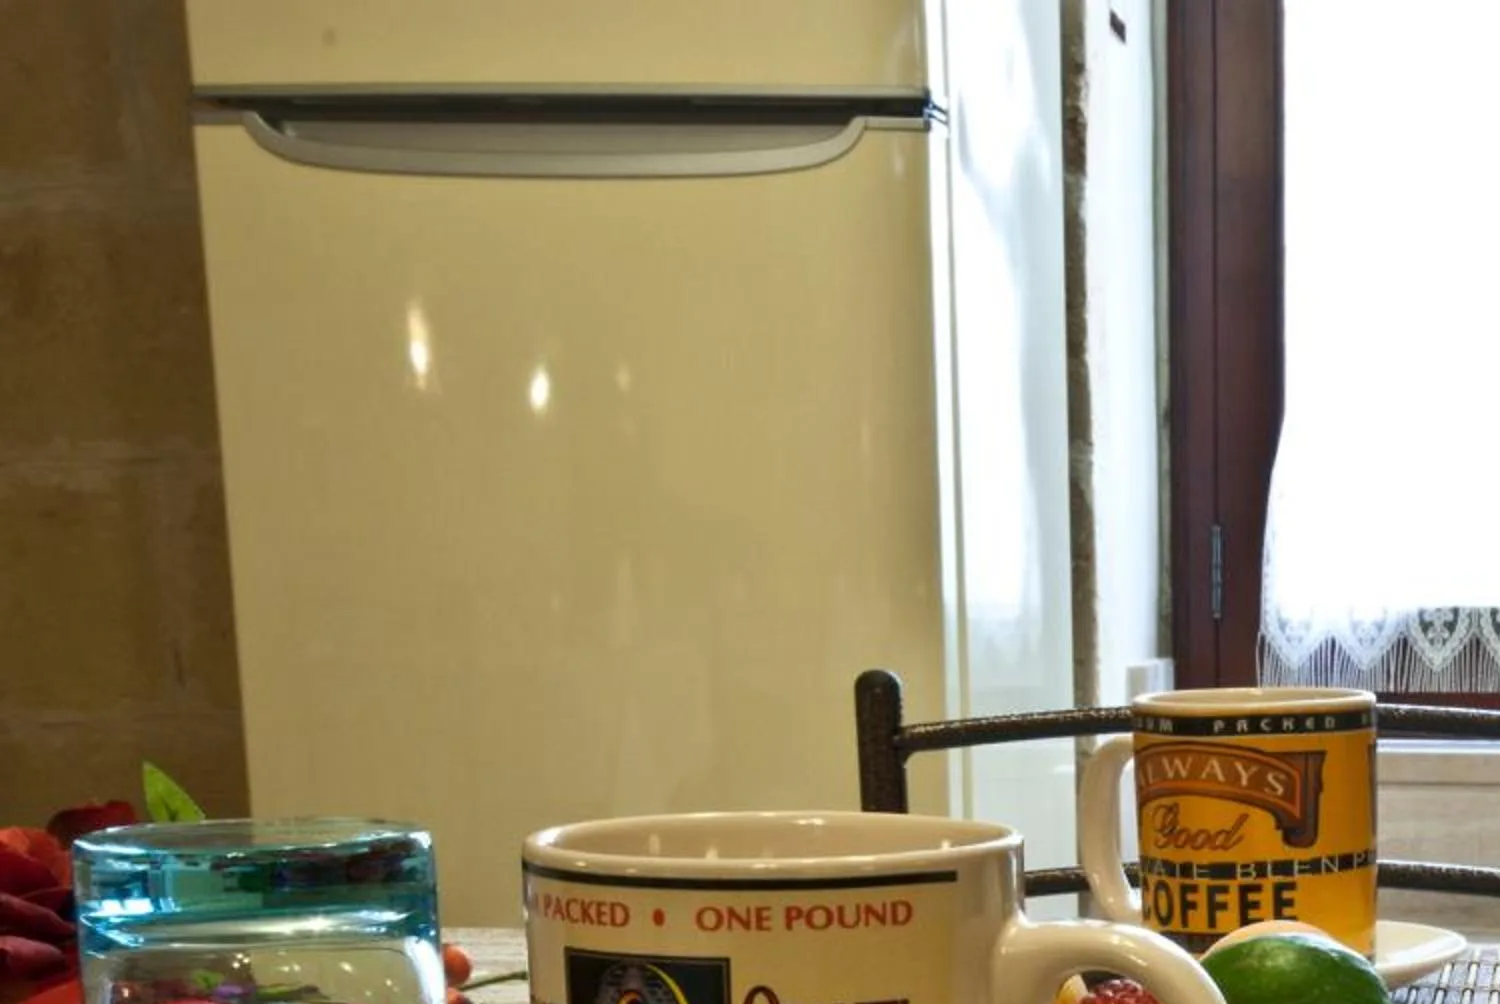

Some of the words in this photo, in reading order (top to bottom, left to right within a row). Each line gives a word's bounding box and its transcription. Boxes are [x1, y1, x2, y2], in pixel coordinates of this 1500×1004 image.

[1151, 801, 1250, 851] Good
[543, 893, 631, 928] PACKED
[694, 905, 772, 932] ONE
[784, 899, 914, 931] POUND
